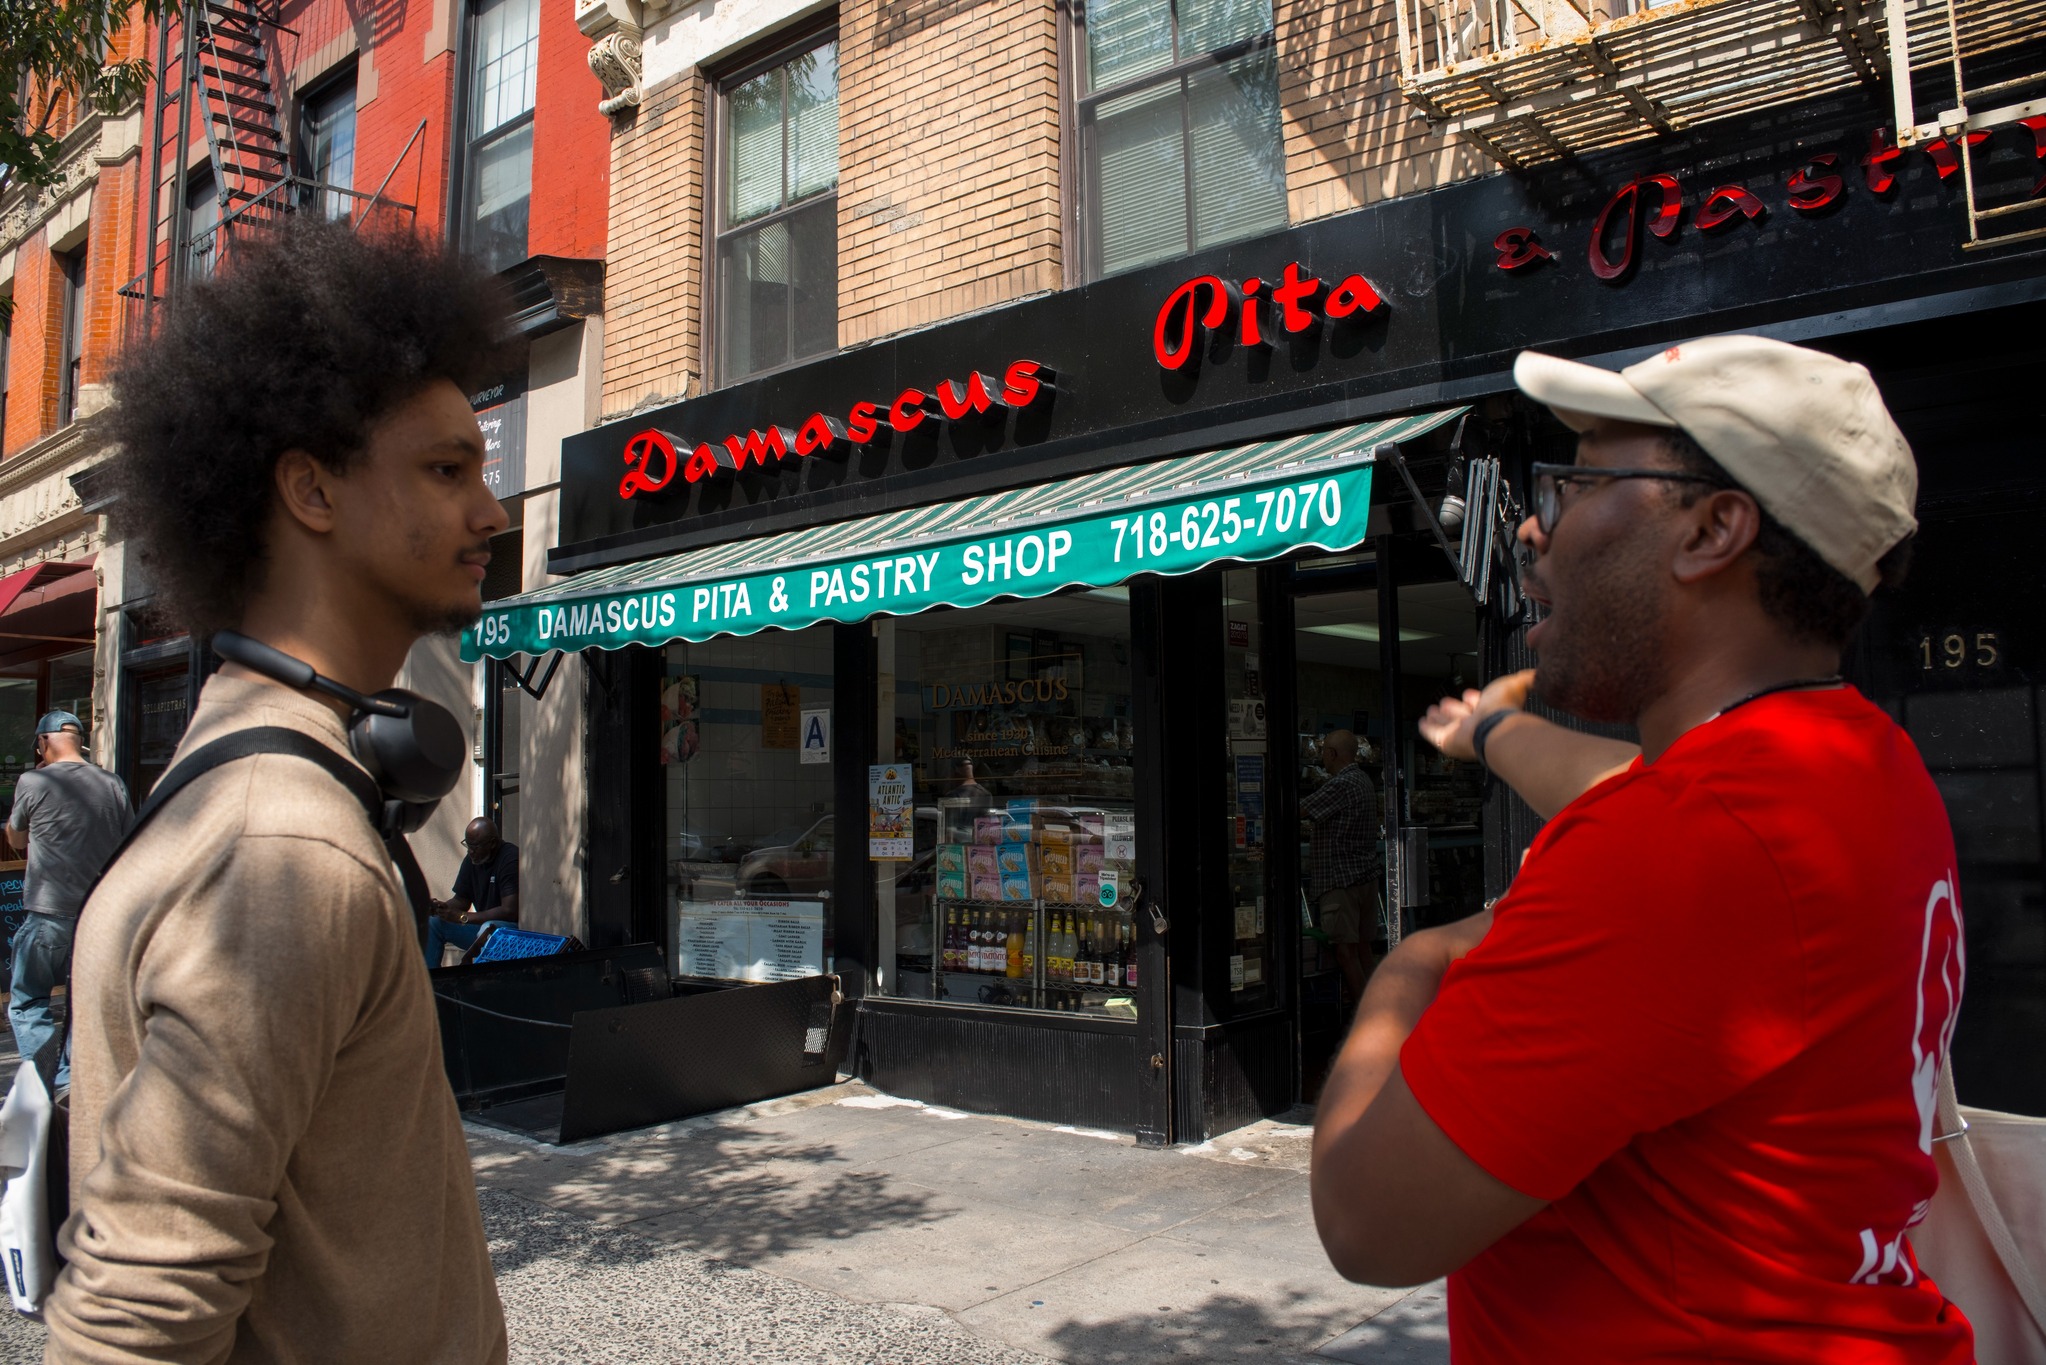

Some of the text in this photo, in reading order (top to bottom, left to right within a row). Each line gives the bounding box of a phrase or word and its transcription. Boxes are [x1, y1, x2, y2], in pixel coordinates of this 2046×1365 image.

[619, 359, 1043, 500] Damascus
[1153, 261, 1383, 370] Pita
[1493, 226, 1555, 270] &
[474, 479, 1342, 647] 195 DAMASCUS PITA & PASTRY SHOP 718-625-7070
[1920, 633, 1997, 670] 195
[931, 678, 1070, 709] DAMASCUS
[804, 716, 825, 749] A
[967, 731, 998, 742] since
[932, 741, 1069, 760] Mediterranean Cuisine
[877, 784, 905, 795] ATLANTIC
[882, 795, 901, 805] ANTIC
